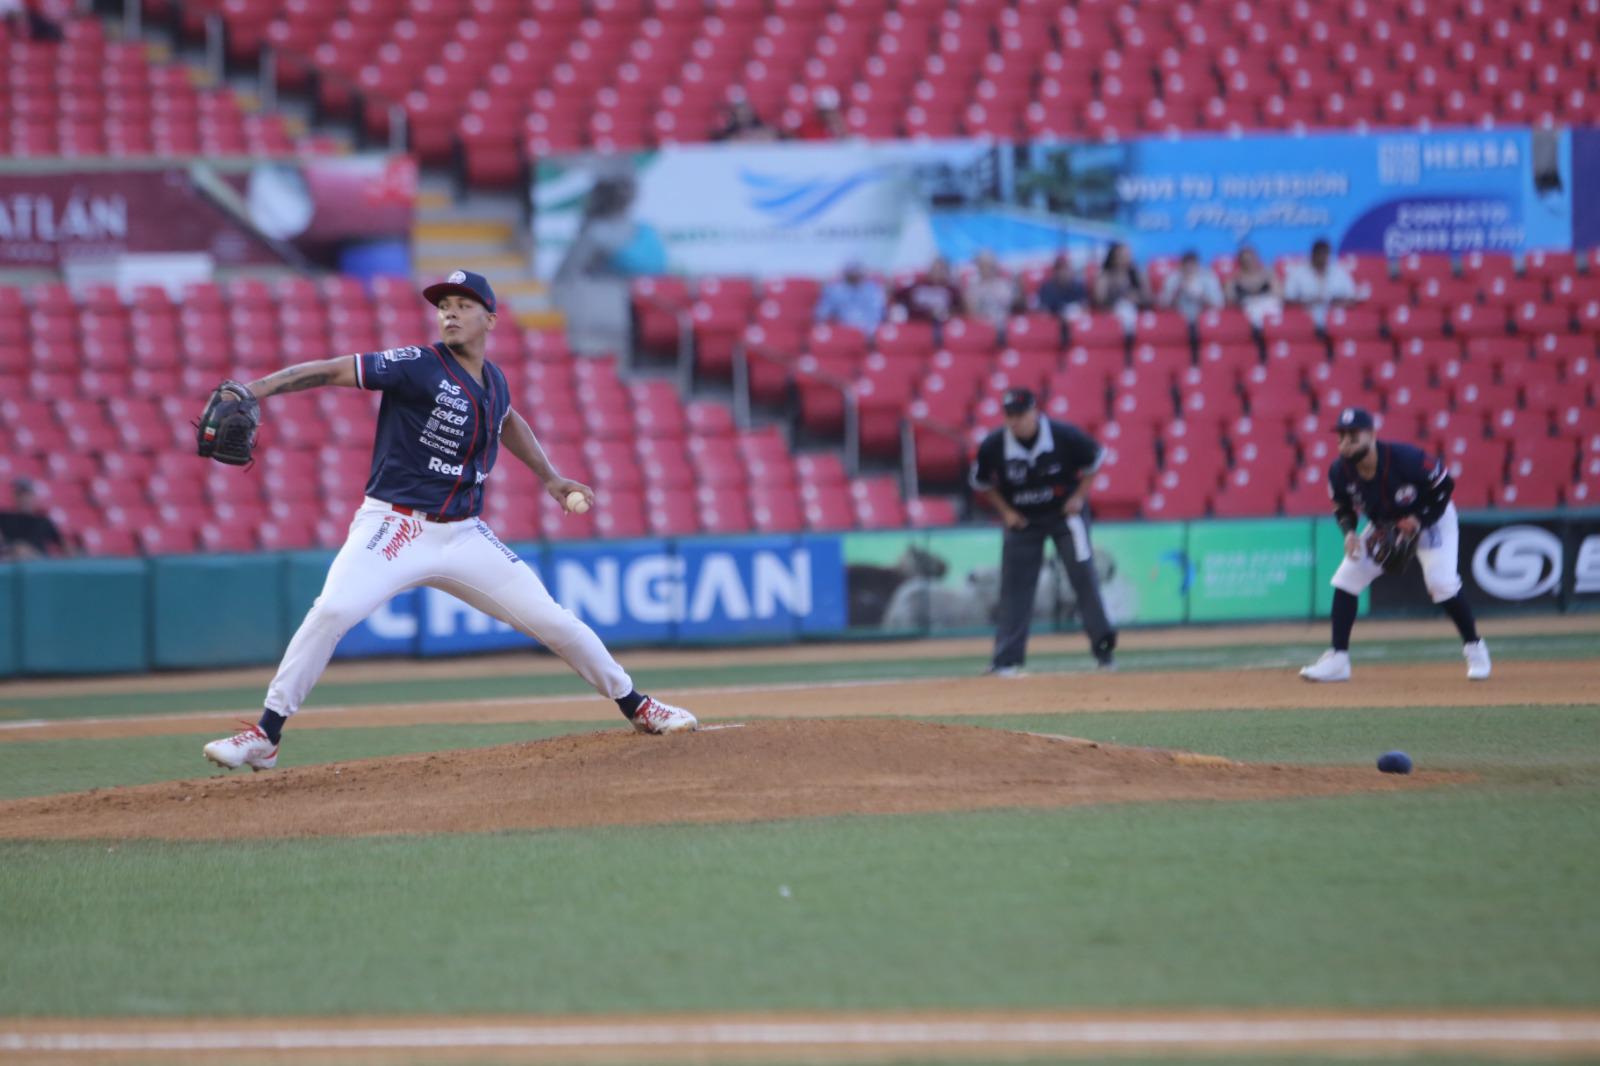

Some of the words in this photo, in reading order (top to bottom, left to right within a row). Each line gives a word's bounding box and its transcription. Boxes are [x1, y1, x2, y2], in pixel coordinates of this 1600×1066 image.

[431, 406, 468, 426] telcel
[439, 424, 464, 437] HERSA
[366, 549, 812, 640] CHNGAN
